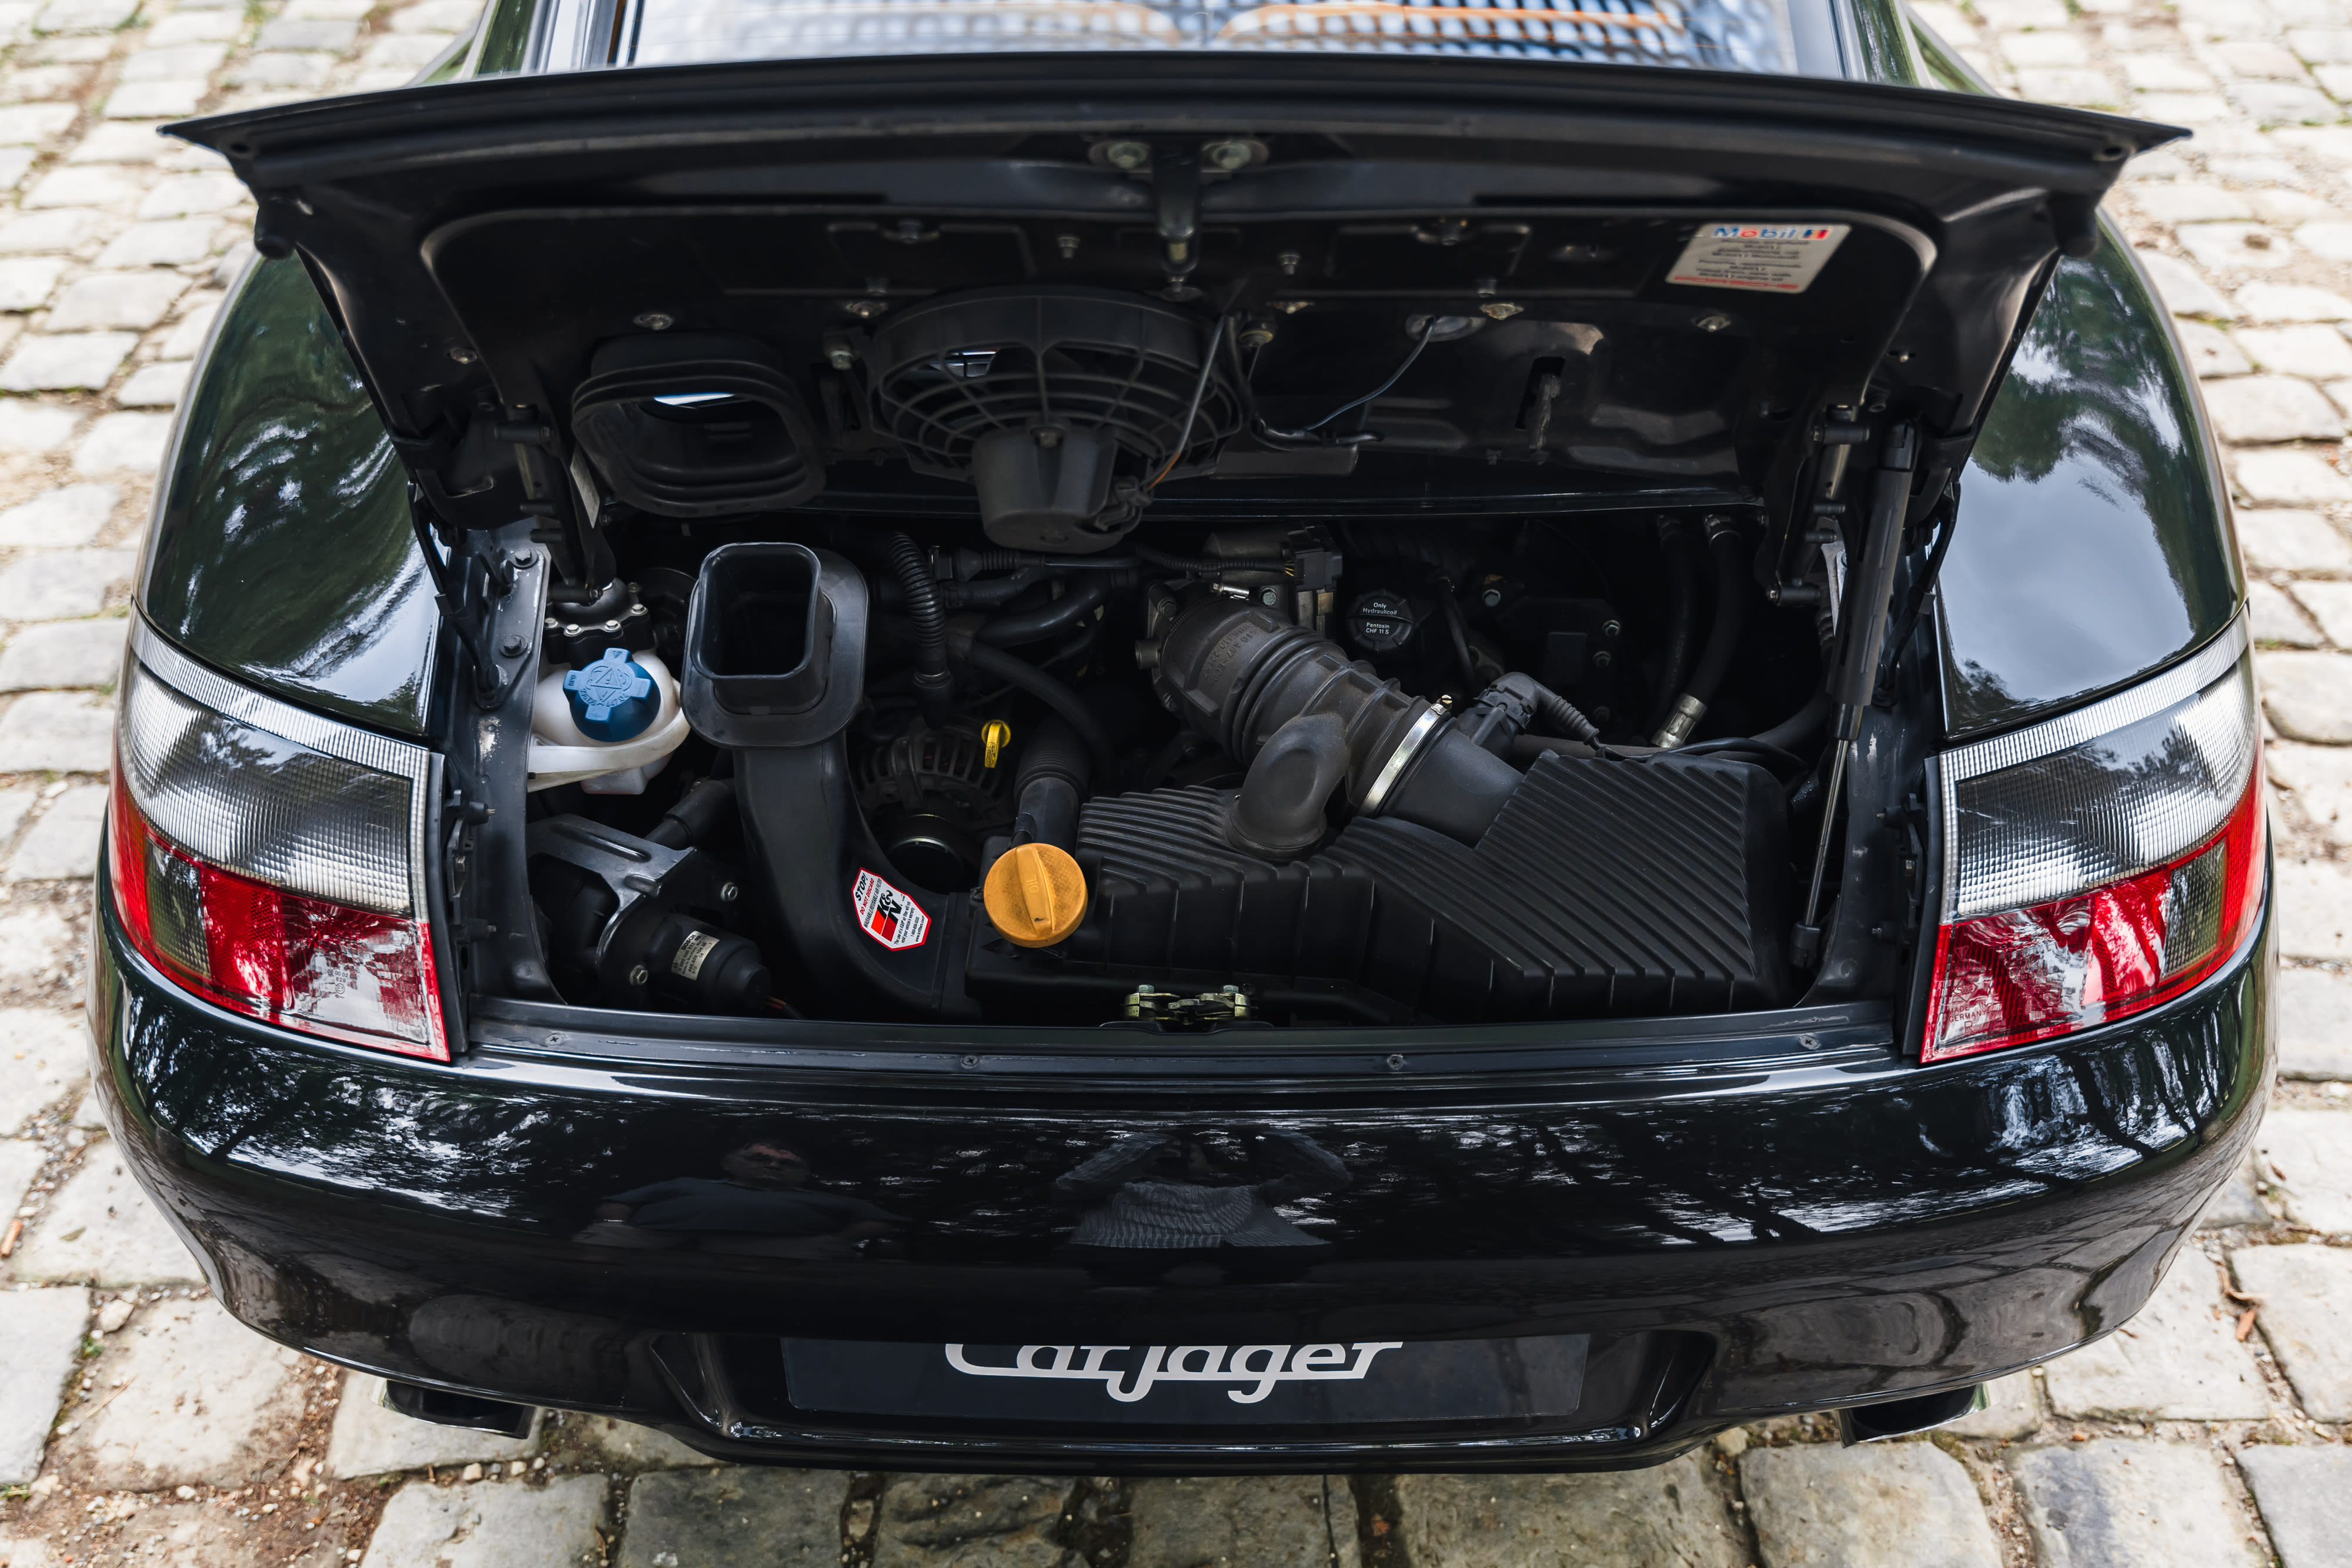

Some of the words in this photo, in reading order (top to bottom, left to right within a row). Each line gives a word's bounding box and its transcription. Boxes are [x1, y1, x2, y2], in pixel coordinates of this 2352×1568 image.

[1713, 227, 1796, 239] Mobil
[856, 873, 868, 901] STOP!
[1026, 875, 1040, 893] OIL
[860, 907, 865, 915] DO
[866, 878, 874, 898] DISCARD
[681, 934, 696, 950] BOSCH
[1948, 1005, 1969, 1014] MADE
[1949, 1009, 1986, 1022] GERMANY
[1964, 1021, 1975, 1034] R
